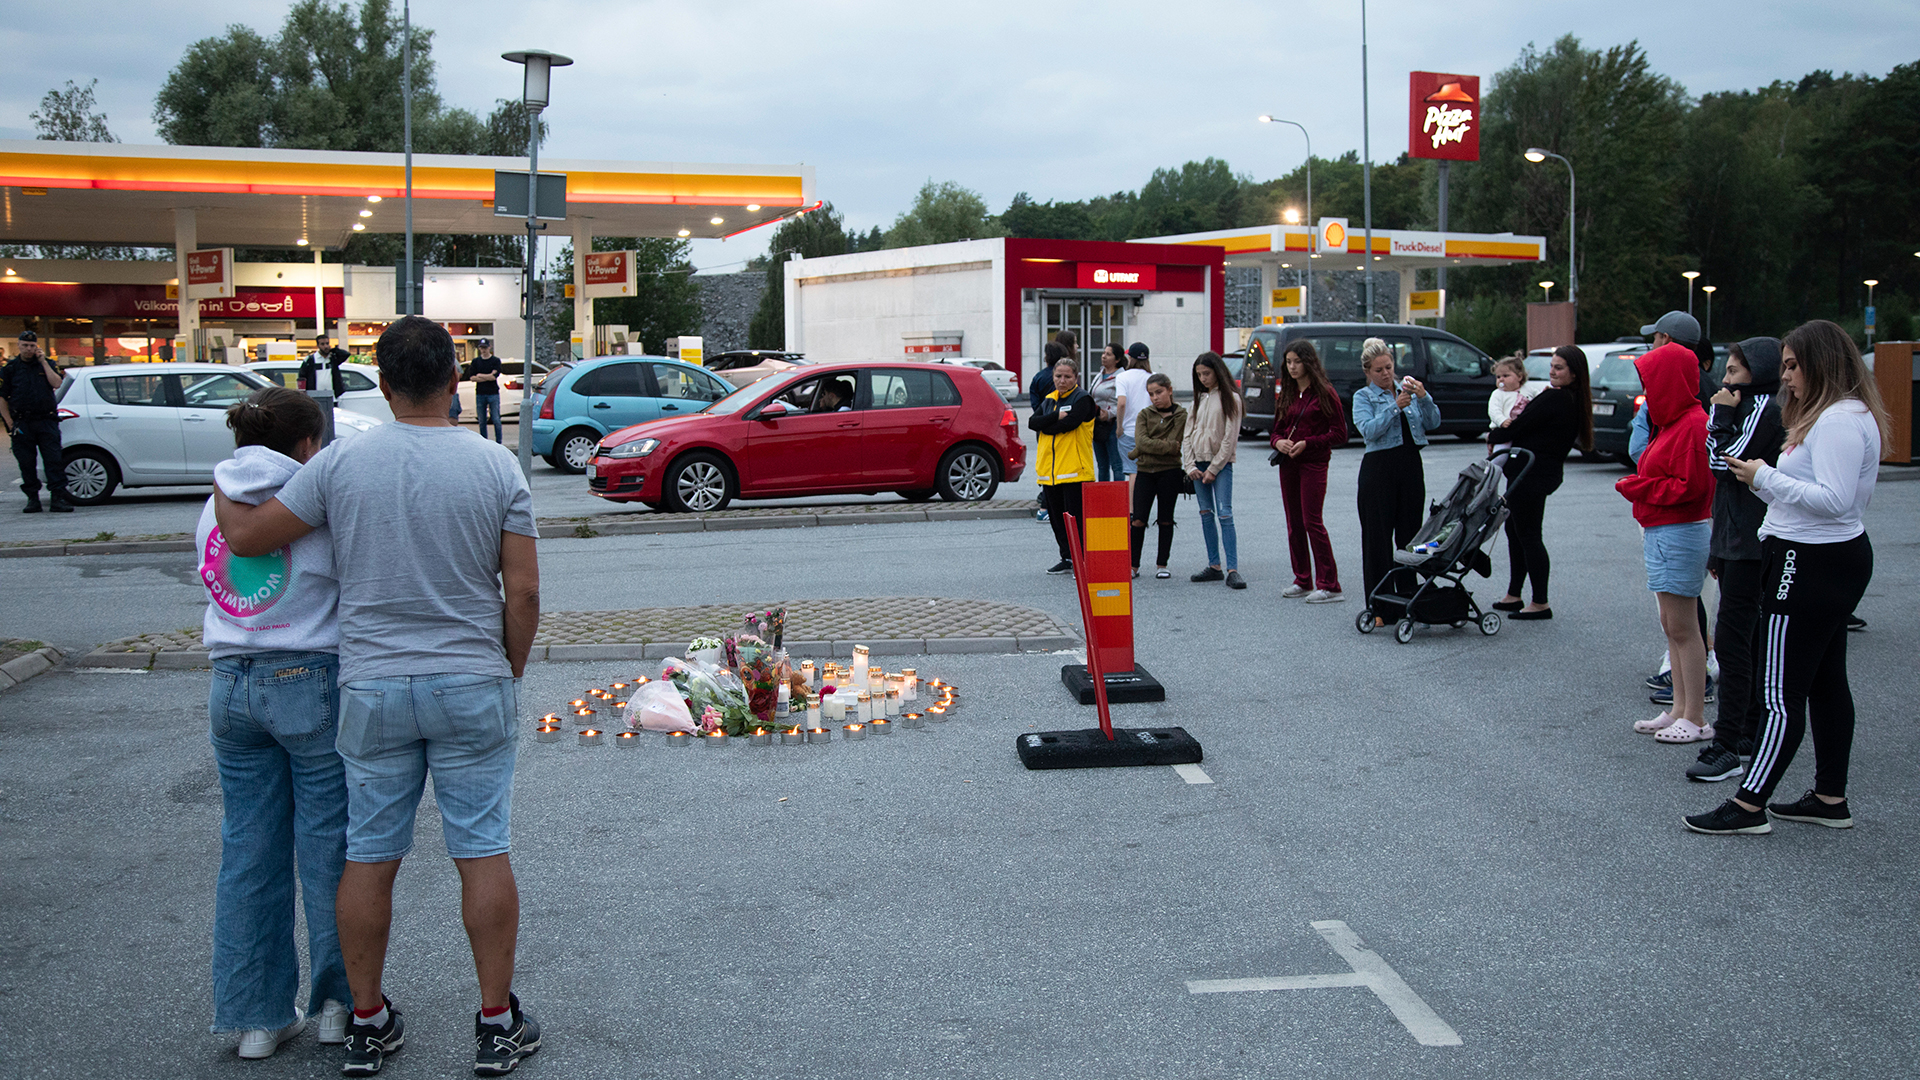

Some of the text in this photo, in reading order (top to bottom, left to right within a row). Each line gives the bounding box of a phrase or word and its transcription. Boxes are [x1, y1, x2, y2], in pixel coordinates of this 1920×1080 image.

[1423, 103, 1473, 133] Pizza
[1431, 122, 1471, 149] Hut
[1394, 241, 1442, 252] TruckDiesel
[588, 266, 618, 275] V-Power
[134, 300, 224, 311] Välkomn in!
[1776, 549, 1797, 600] adidas
[205, 570, 282, 612] worldwide
